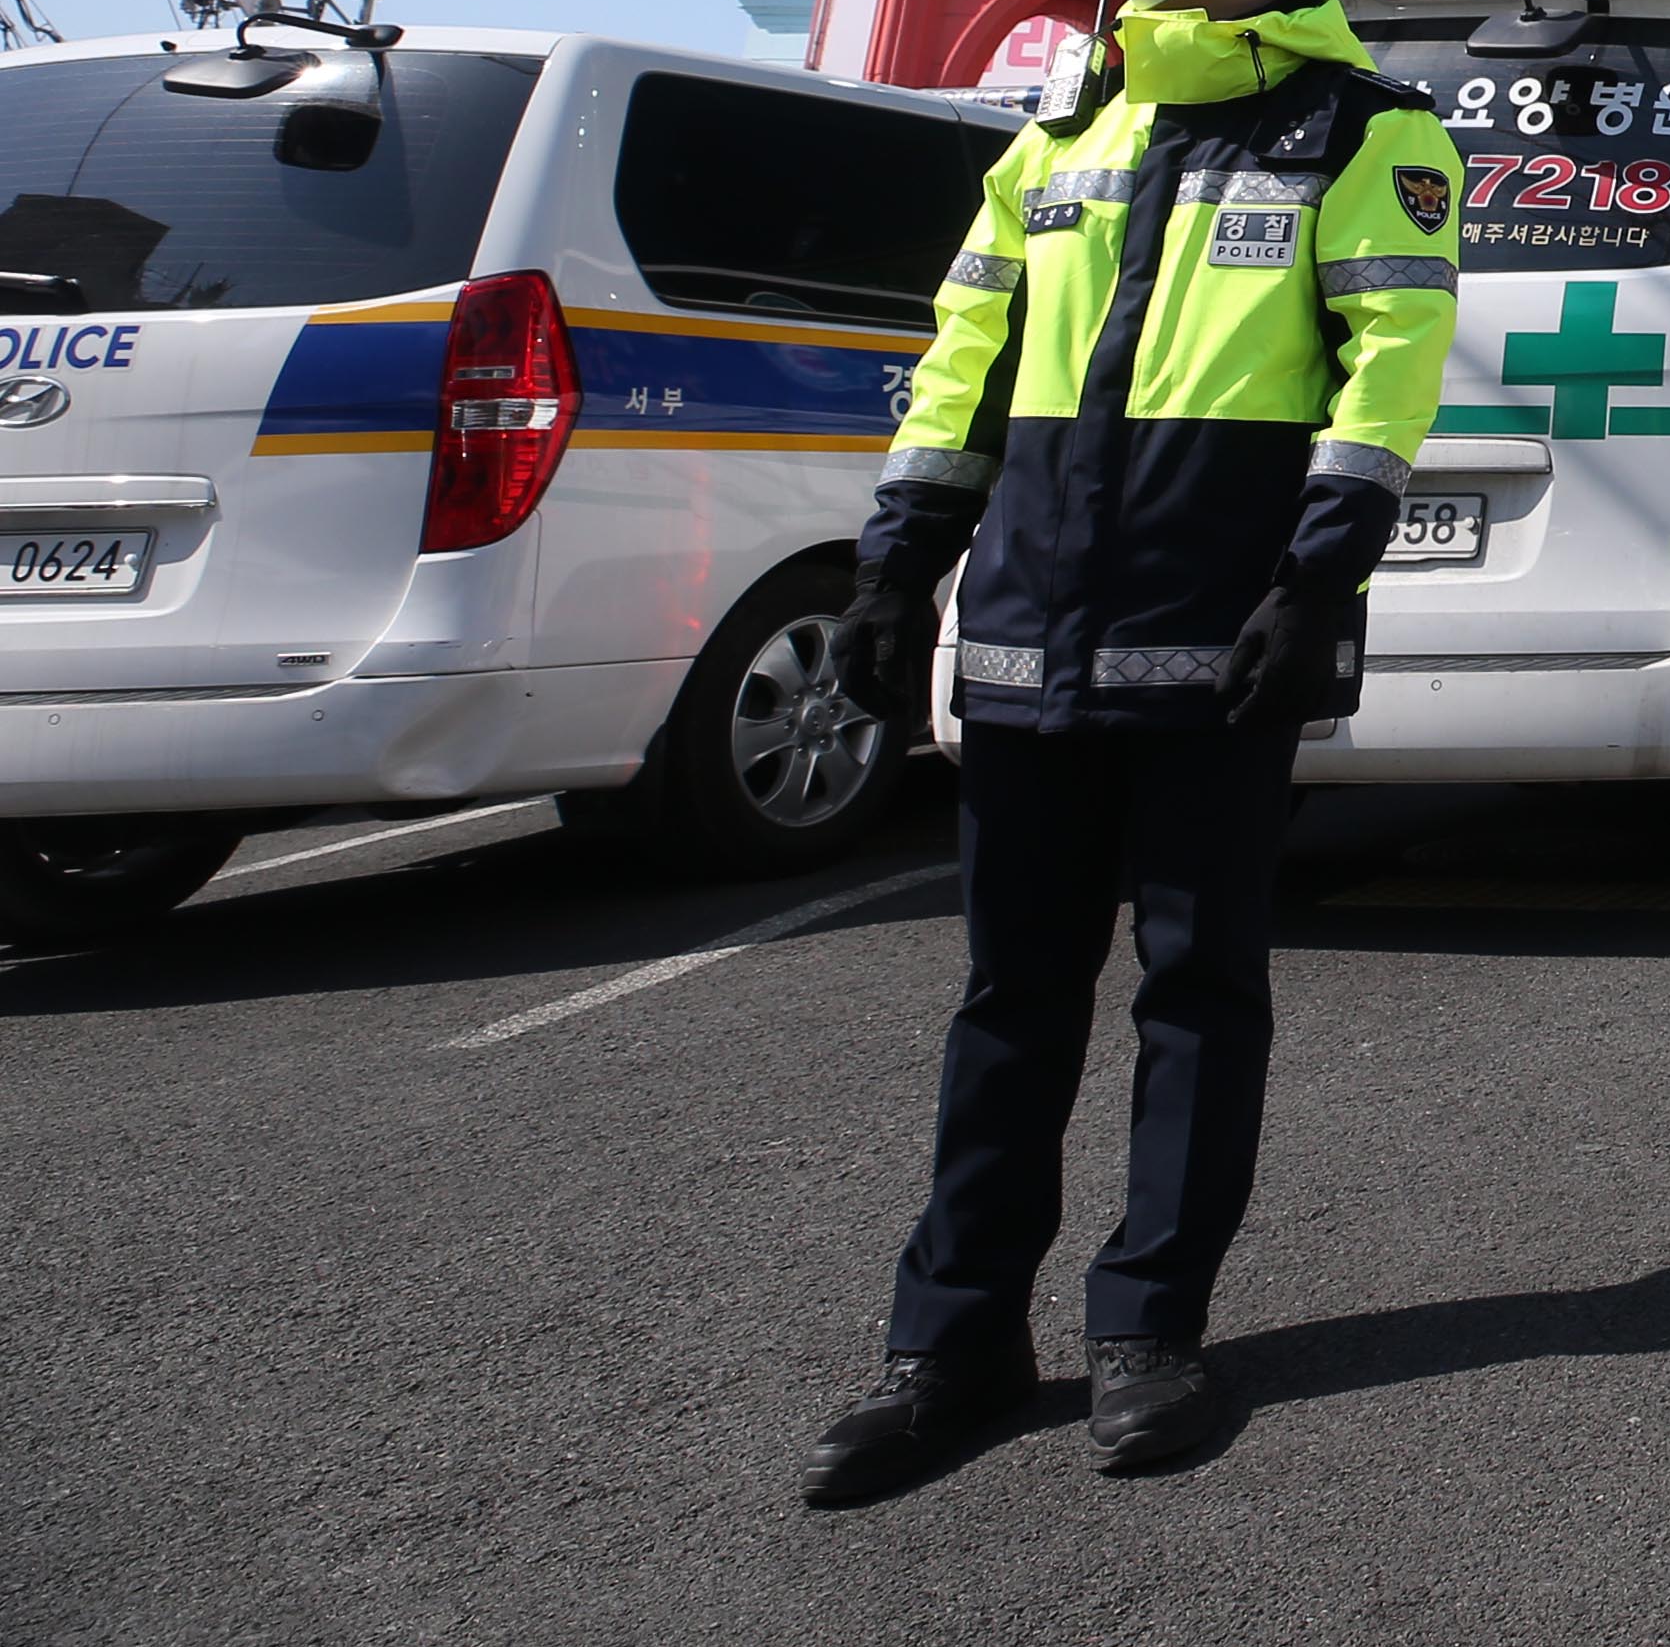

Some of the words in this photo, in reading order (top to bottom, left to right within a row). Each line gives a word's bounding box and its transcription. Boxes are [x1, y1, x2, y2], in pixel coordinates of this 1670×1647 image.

[1223, 214, 1289, 241] 경찰
[1417, 210, 1441, 220] POLICE
[1217, 246, 1286, 259] POLICE
[625, 386, 684, 415] 서부
[1387, 503, 1457, 545] 58
[12, 539, 122, 583] 0624
